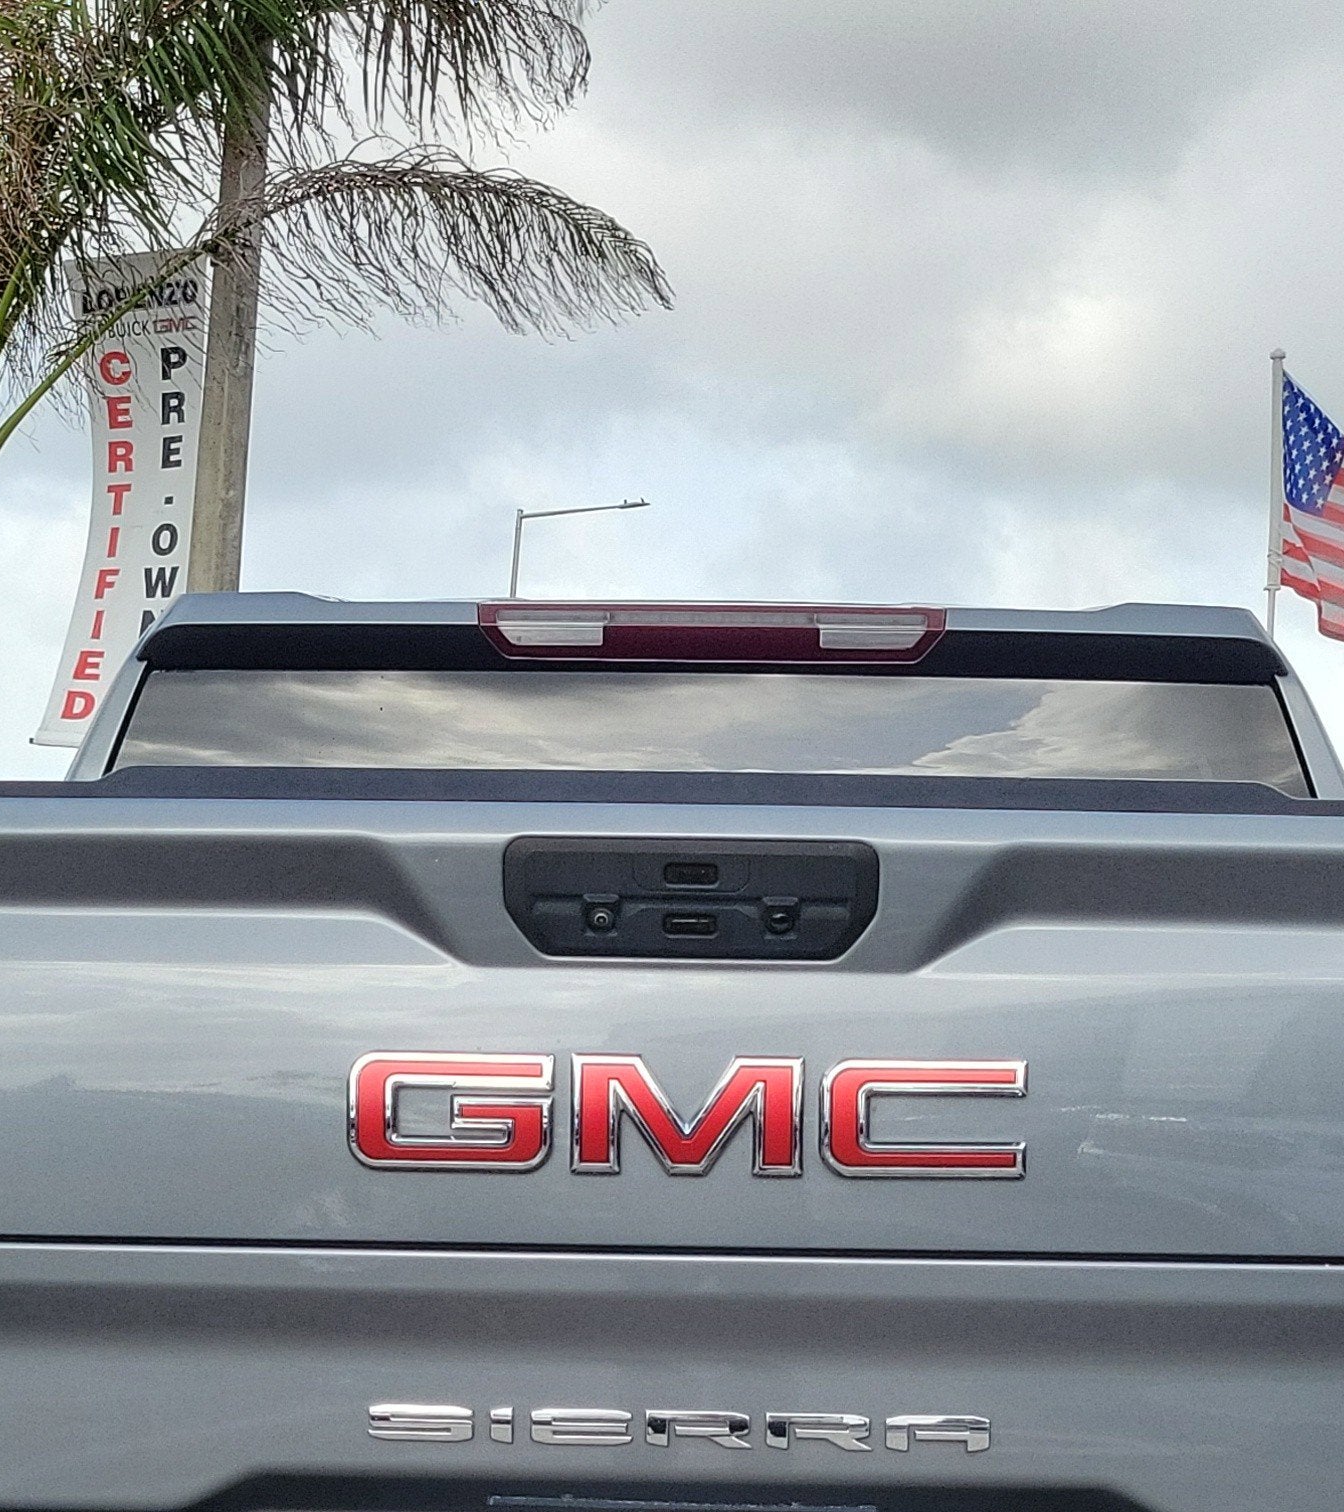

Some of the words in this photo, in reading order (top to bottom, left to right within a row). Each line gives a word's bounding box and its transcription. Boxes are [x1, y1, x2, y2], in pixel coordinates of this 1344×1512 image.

[61, 350, 134, 721] CERTIFIED
[347, 1050, 1028, 1180] GMC
[368, 1403, 992, 1452] SIERRA
